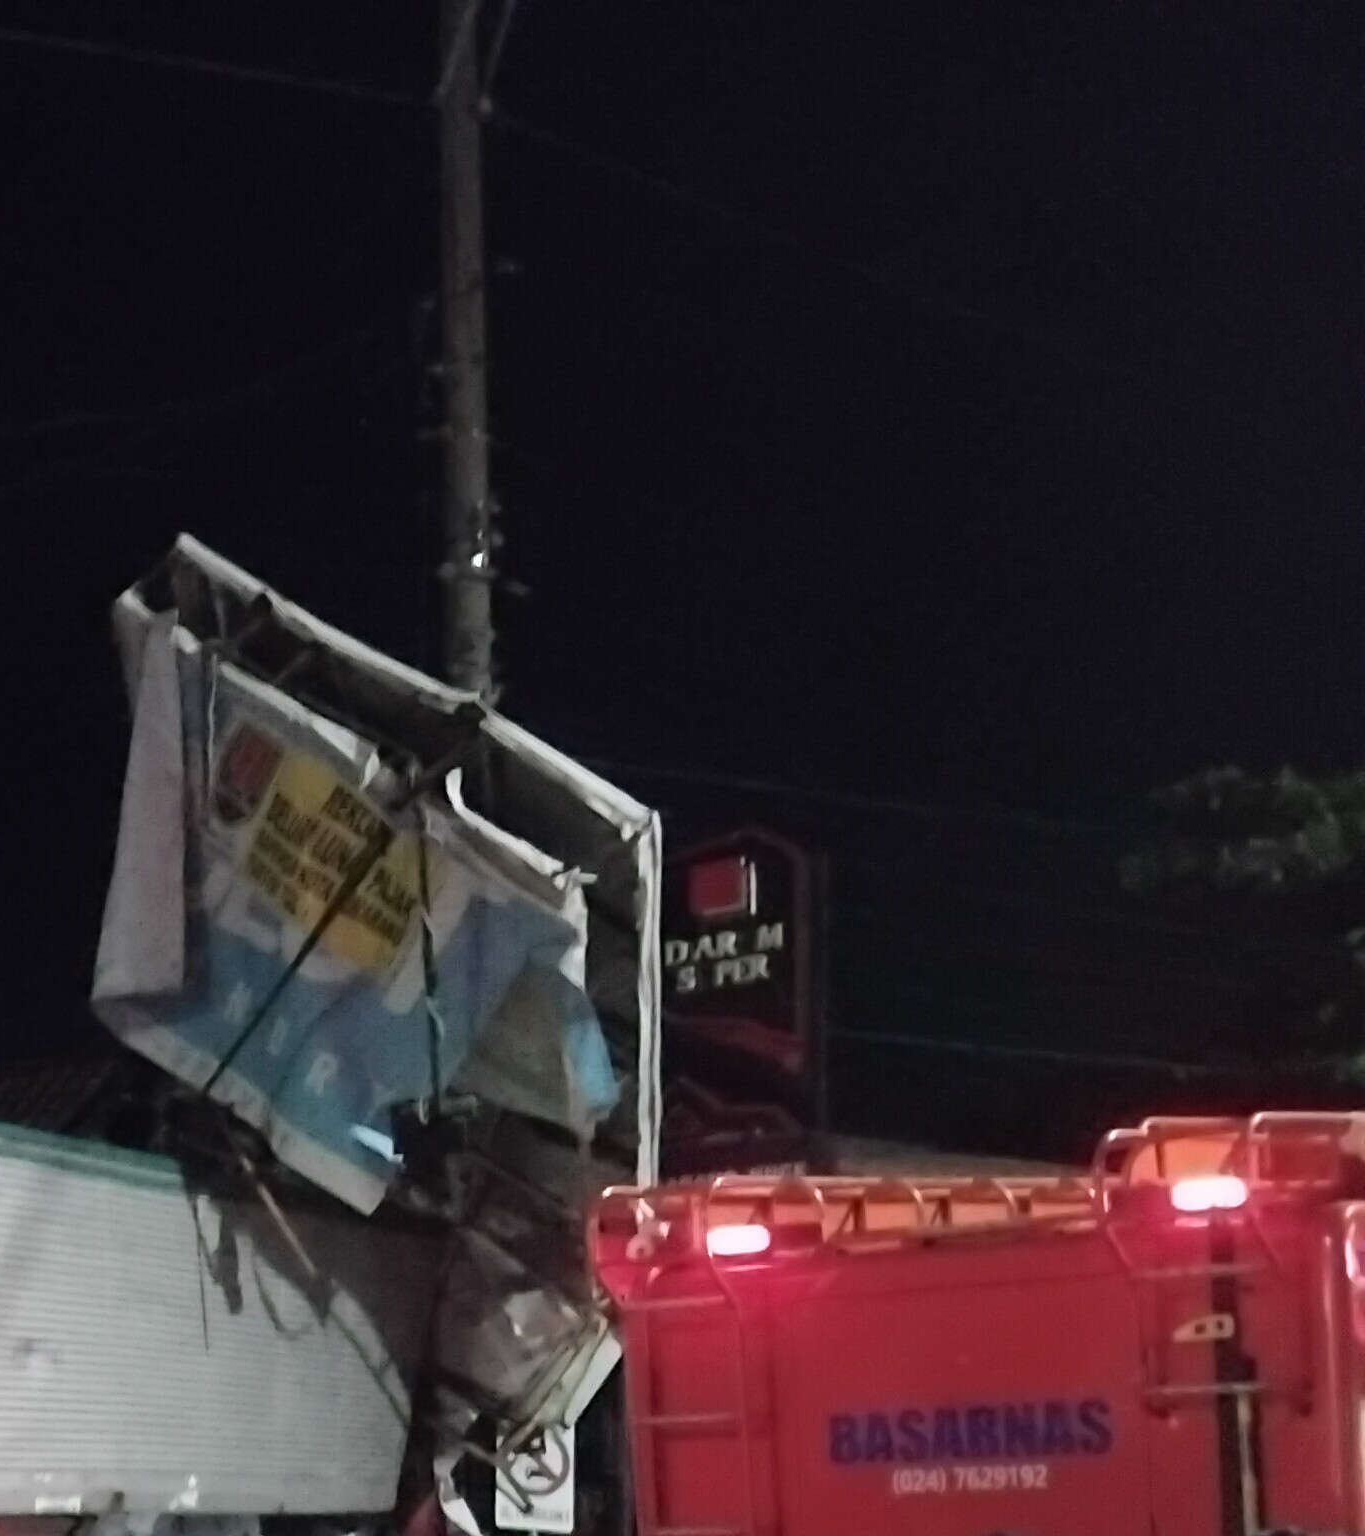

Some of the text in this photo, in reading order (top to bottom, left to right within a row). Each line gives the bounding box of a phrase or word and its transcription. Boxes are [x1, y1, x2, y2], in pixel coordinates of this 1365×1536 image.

[829, 1398, 1112, 1464] BASARNAS
[892, 1464, 1048, 1494] (024) 7629192
